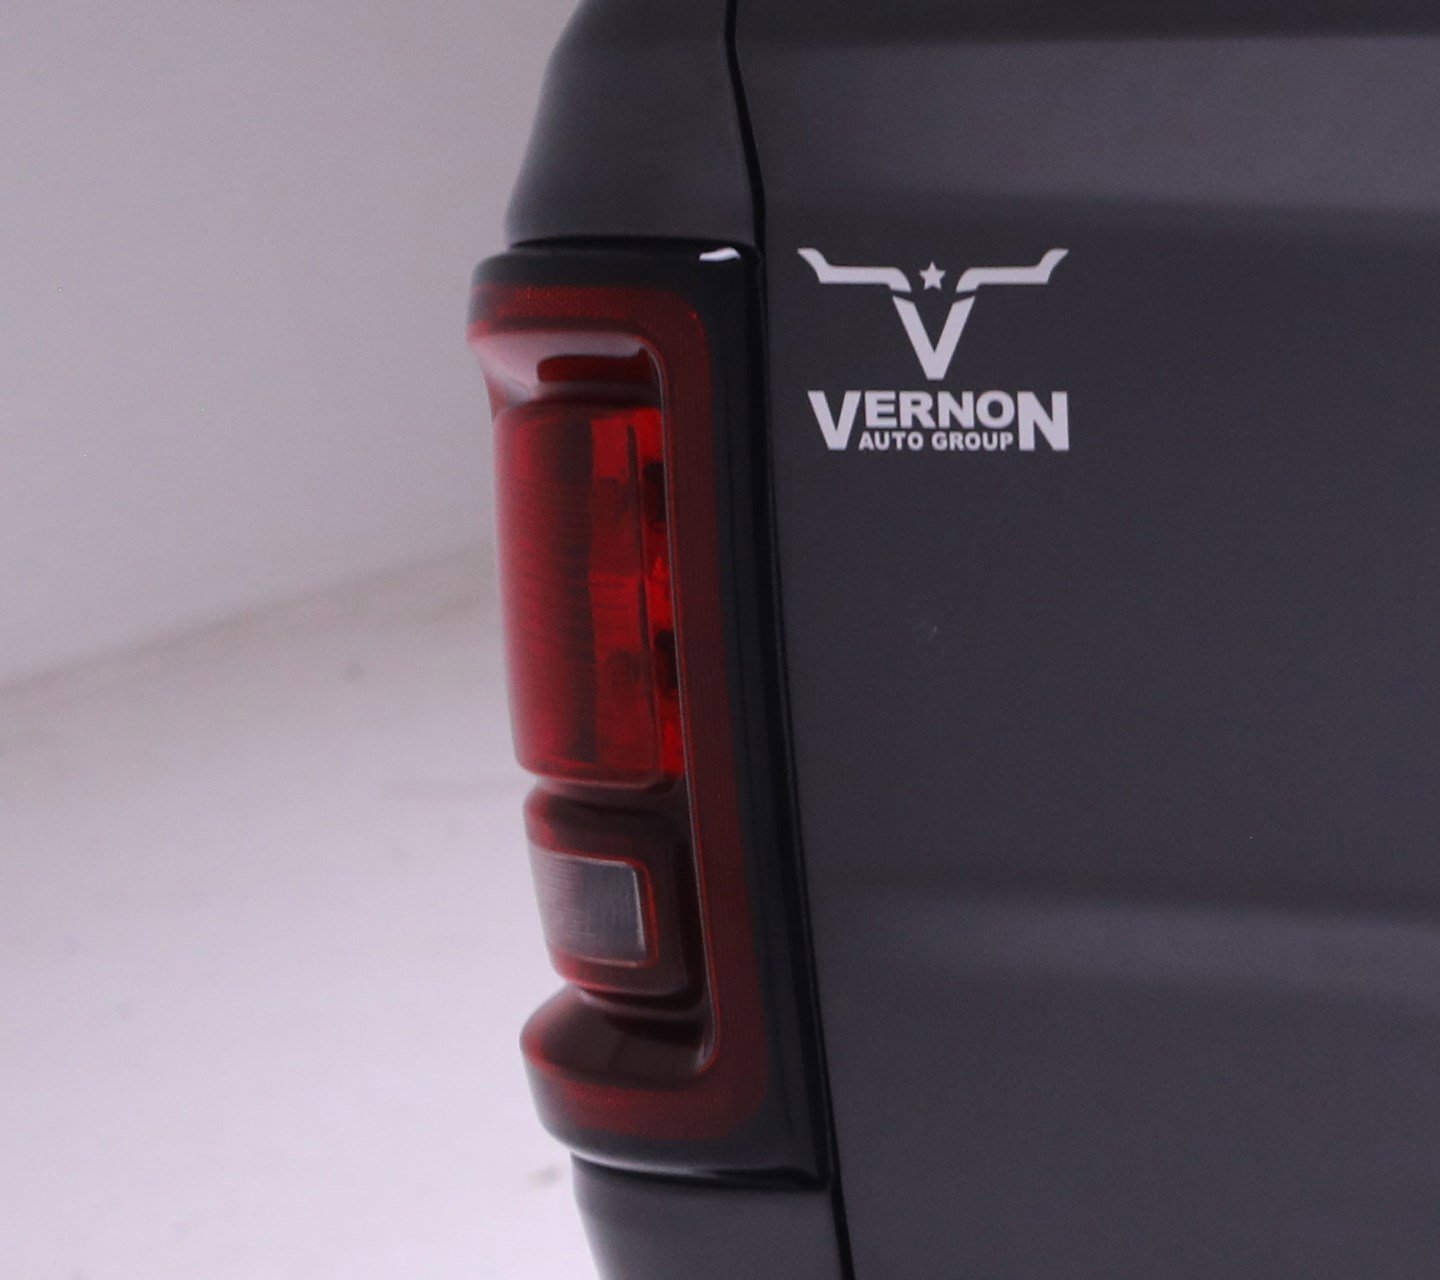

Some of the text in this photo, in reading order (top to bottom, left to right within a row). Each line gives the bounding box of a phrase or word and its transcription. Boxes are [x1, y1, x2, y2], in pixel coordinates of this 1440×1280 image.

[807, 390, 1070, 452] VERNON
[858, 431, 1014, 451] AUTO GROUP
